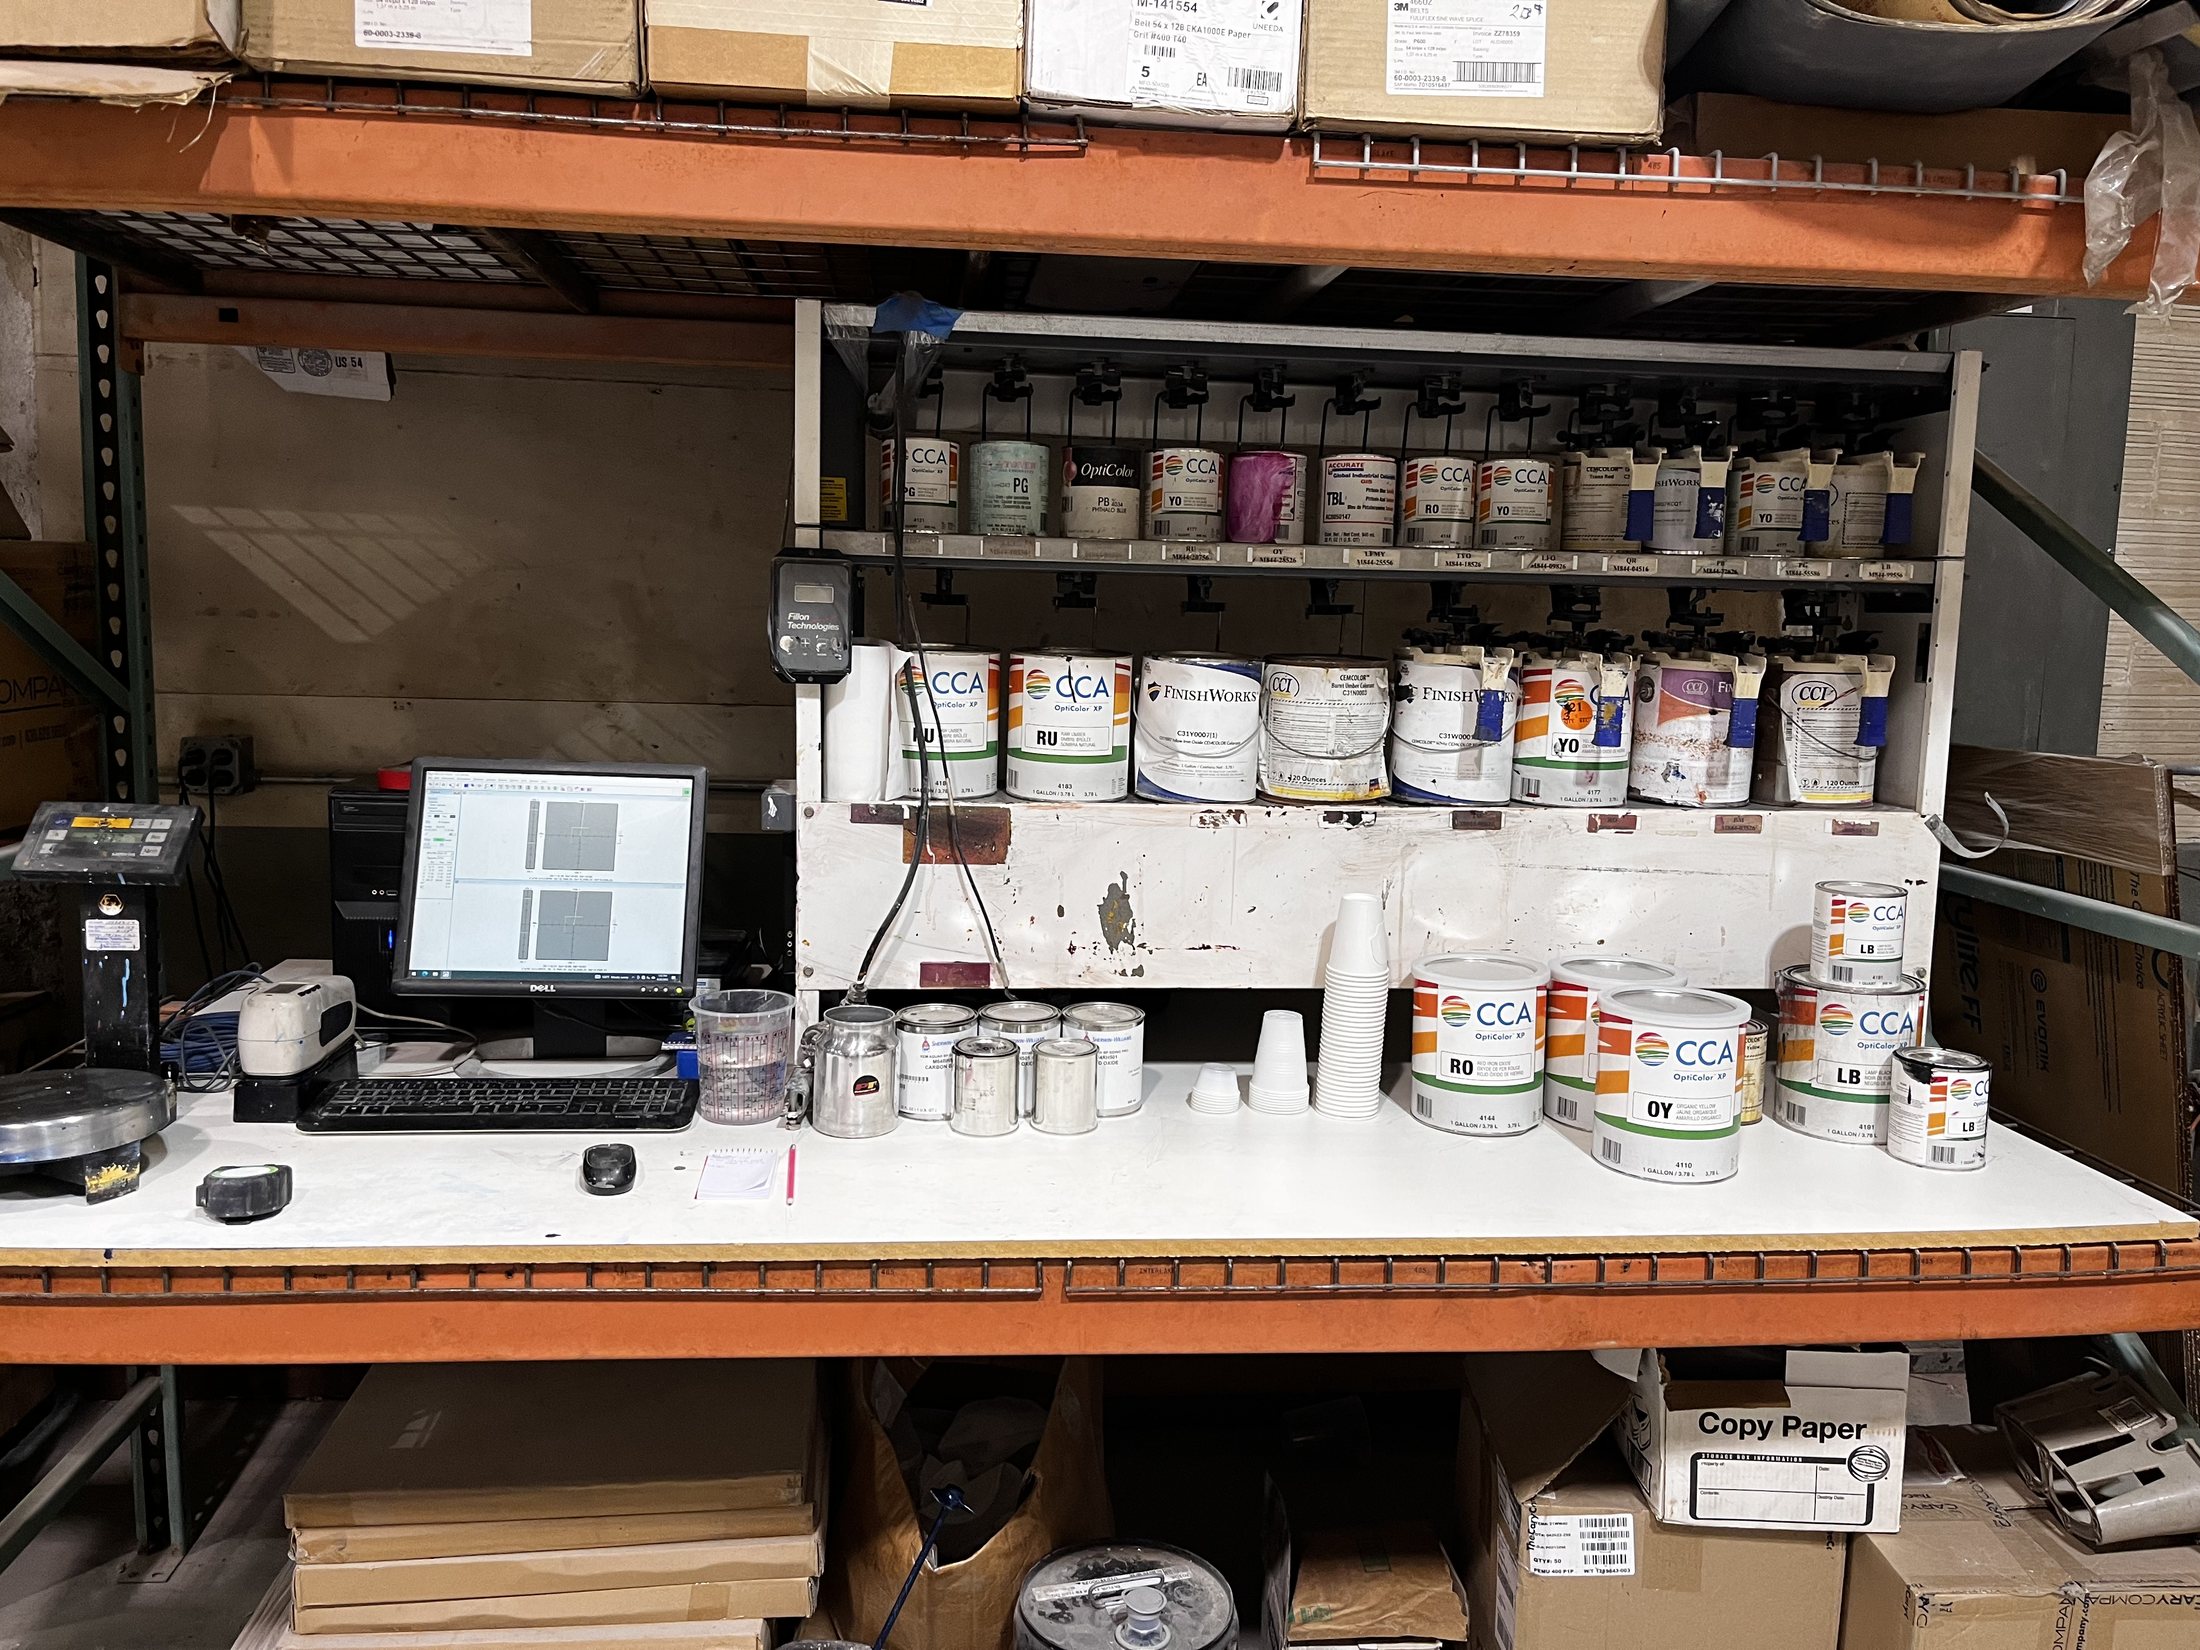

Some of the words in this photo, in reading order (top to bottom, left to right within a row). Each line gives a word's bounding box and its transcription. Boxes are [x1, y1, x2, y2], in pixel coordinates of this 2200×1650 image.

[1394, 3, 1409, 12] 3M
[1134, 18, 1151, 27] Belt
[1152, 20, 1163, 29] 54
[1170, 22, 1186, 32] 128
[1186, 24, 1226, 37] EKA1000E
[1227, 29, 1251, 40] Paper
[1252, 23, 1284, 33] UNEEDA
[1133, 30, 1149, 40] Grit
[1172, 34, 1188, 44] T40
[1141, 65, 1151, 78] 5
[1196, 72, 1208, 87] EA
[335, 356, 348, 368] US
[351, 357, 363, 368] 54
[911, 448, 947, 466] CCA
[1080, 462, 1135, 479] OptiColor
[1186, 458, 1217, 475] CCA
[1328, 462, 1365, 471] ACCURATE
[1441, 467, 1471, 484] CCA
[1514, 468, 1548, 485] CCA
[1012, 477, 1029, 494] PG
[1097, 496, 1110, 506] PB
[1168, 495, 1182, 506] YO
[1326, 491, 1345, 506] TBL
[1425, 504, 1440, 514] RO
[1496, 506, 1510, 516] YO
[1759, 513, 1773, 523] YO
[787, 612, 810, 621] Fillon
[787, 621, 840, 632] Technologies
[931, 670, 985, 695] CCA
[1055, 674, 1107, 699] CCA
[1272, 676, 1293, 693] CCI
[1685, 680, 1705, 692] CCI
[1163, 684, 1257, 703] FINISHWORKS
[1799, 685, 1828, 701] CCI
[1054, 704, 1089, 713] OptiColor
[1036, 729, 1058, 747] RU
[1558, 738, 1580, 754] YO
[1301, 775, 1327, 784] Ounces
[1825, 779, 1839, 787] 120
[1035, 789, 1056, 797] GALLON
[2130, 870, 2141, 897] The
[1873, 905, 1904, 921] CCA
[1859, 944, 1875, 954] LB
[530, 984, 556, 993] DELL
[1476, 1001, 1532, 1026] CCA
[1859, 1011, 1914, 1036] CCA
[1475, 1032, 1513, 1041] OptiColor
[1857, 1041, 1896, 1050] OptiColor
[1675, 1040, 1733, 1066] CCA
[1450, 1057, 1474, 1076] RO
[1673, 1073, 1714, 1082] OptiColor
[1836, 1067, 1861, 1085] LB
[1647, 1100, 1673, 1119] OY
[1454, 1121, 1479, 1129] GALLON
[1962, 1121, 1975, 1132] LB
[1831, 1129, 1858, 1138] GALLON
[1647, 1168, 1674, 1177] GALLON
[1698, 1411, 1774, 1441] Copy
[1782, 1415, 1868, 1444] Paper
[1701, 1453, 1734, 1461] STORAGE
[1753, 1455, 1803, 1464] INFORMATION
